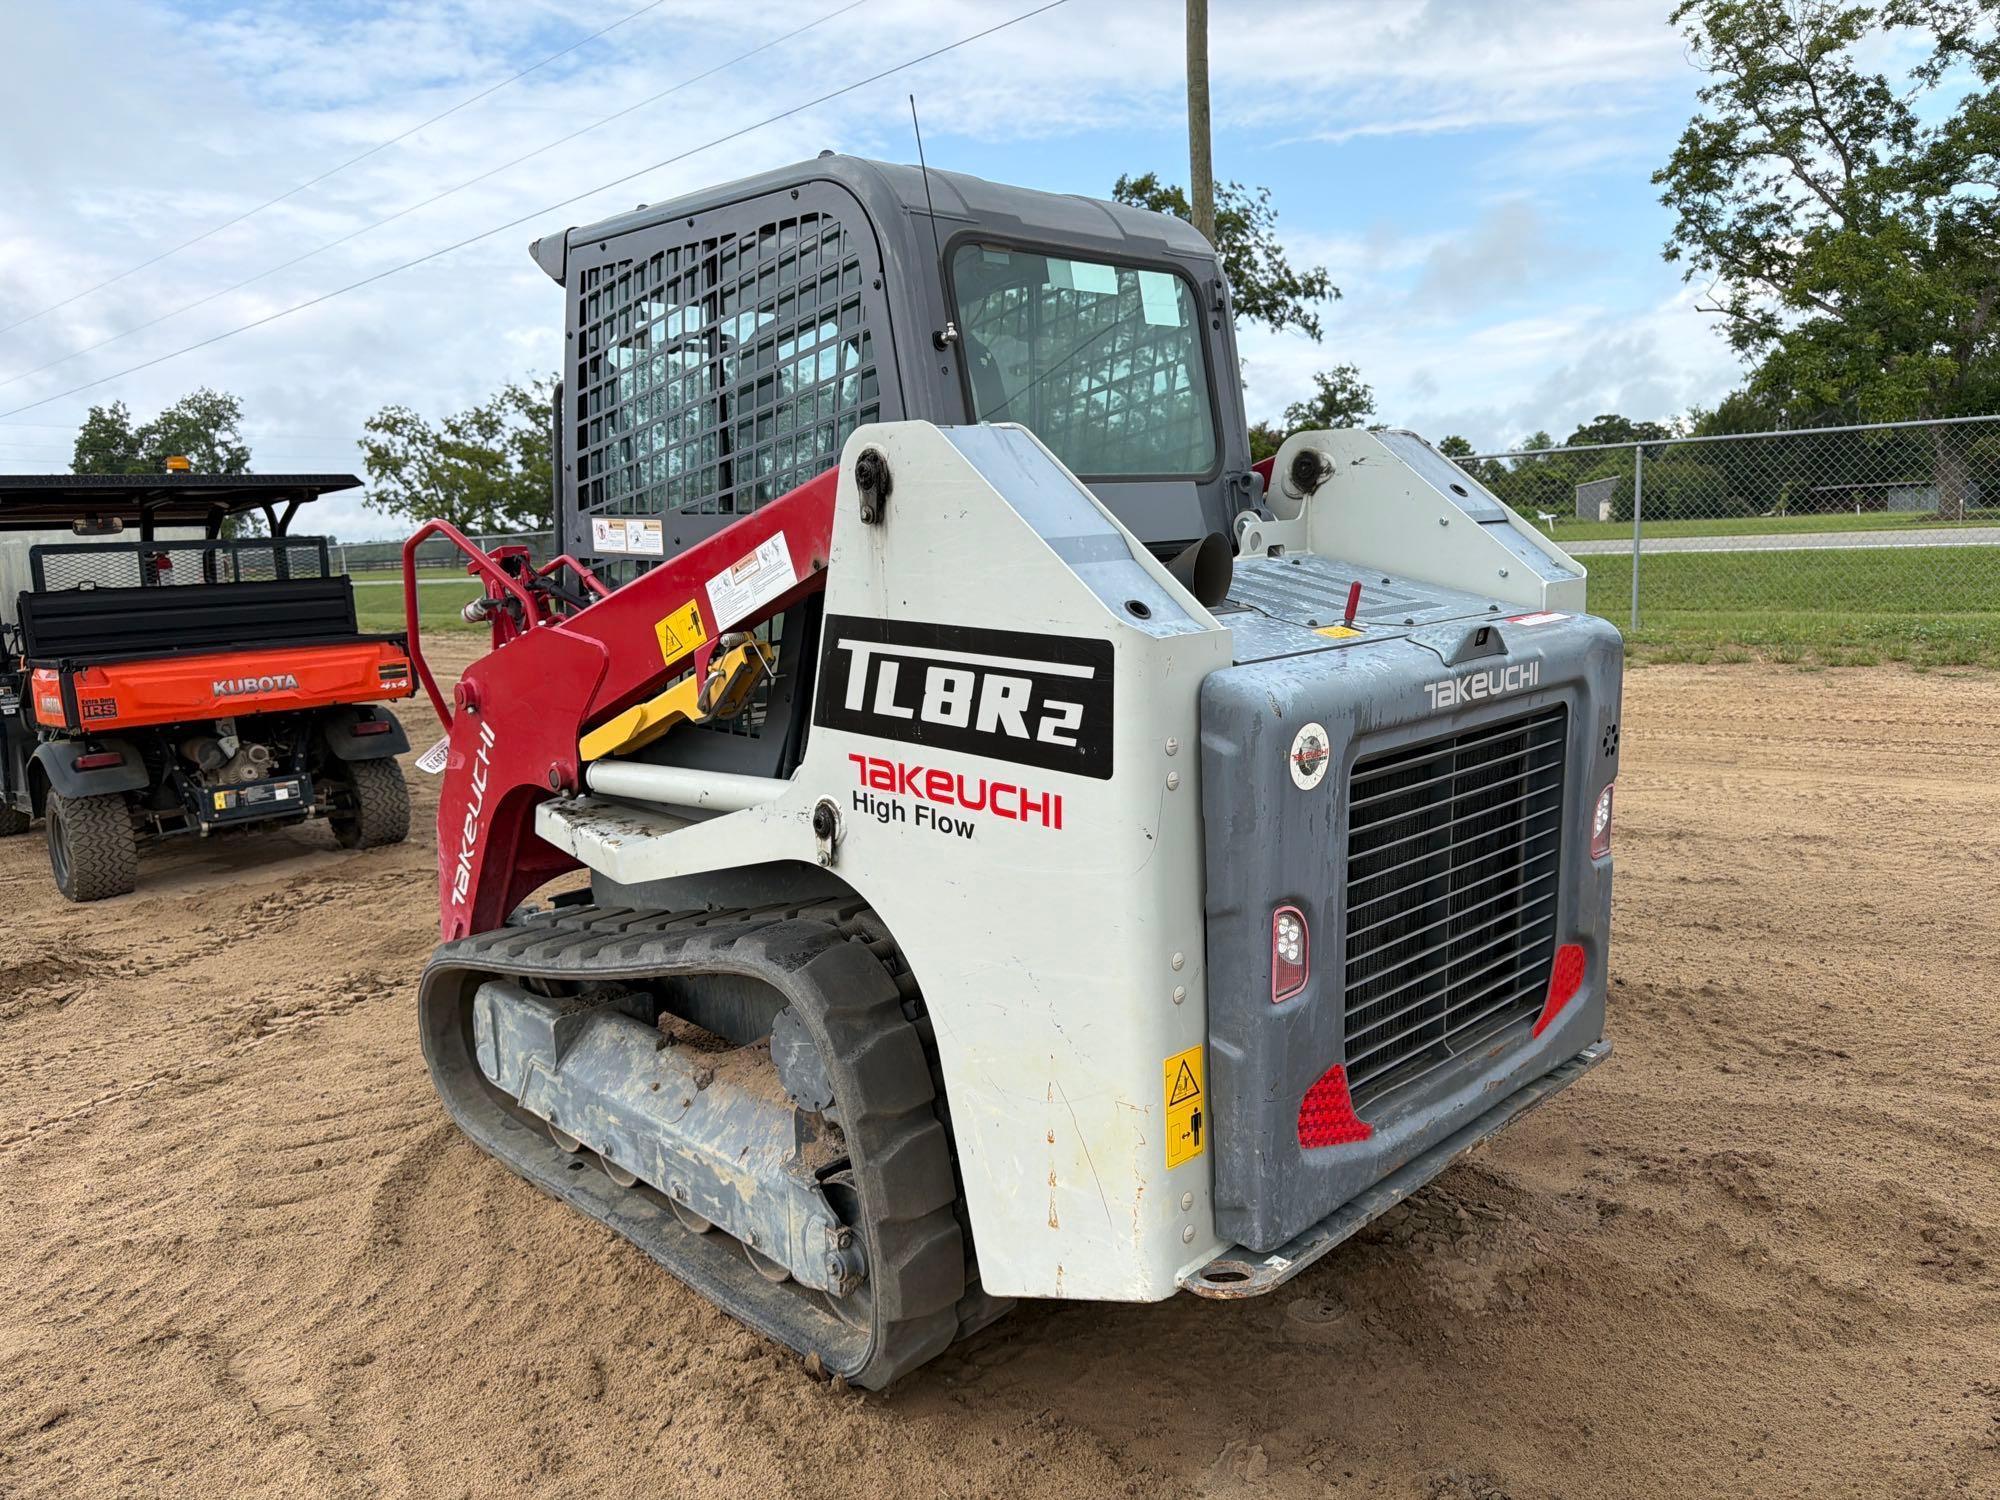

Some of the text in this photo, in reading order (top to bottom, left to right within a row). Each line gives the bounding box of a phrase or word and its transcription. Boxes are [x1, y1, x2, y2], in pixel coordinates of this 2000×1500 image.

[84, 704, 115, 716] IRS
[213, 674, 299, 697] KUBOTA
[837, 638, 1095, 747] TL8R2
[1424, 661, 1539, 709] TAKEUCHI
[451, 721, 496, 906] TAKEUCHI
[849, 753, 1063, 830] TAKEUCHI
[852, 790, 976, 840] High Flow
